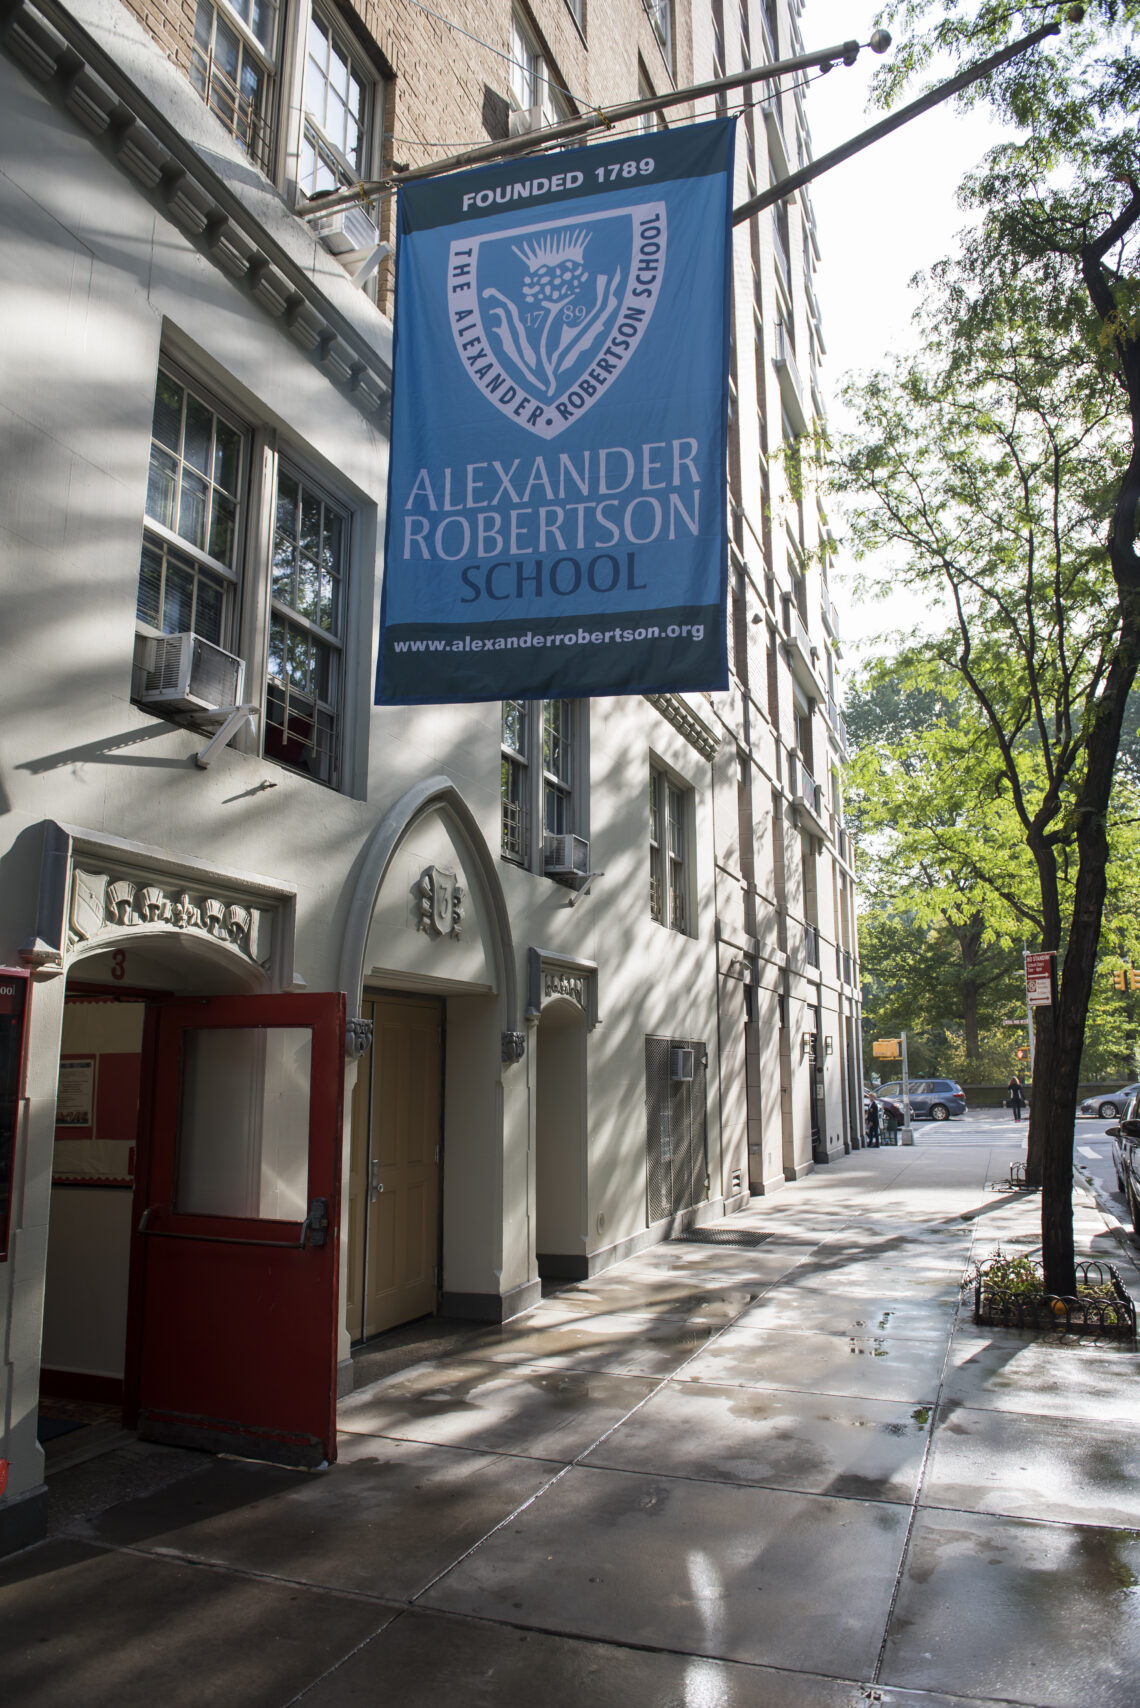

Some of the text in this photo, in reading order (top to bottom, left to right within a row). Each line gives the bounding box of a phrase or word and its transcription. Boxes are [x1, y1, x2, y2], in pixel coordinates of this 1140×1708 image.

[462, 157, 655, 212] FOUNDED 1789
[452, 213, 661, 427] THE ALEXANDER ROBERTSON SCHOOL
[524, 303, 587, 329] 17 89
[404, 437, 701, 512] ALEXANDER
[402, 489, 701, 561] ROBERTSON
[460, 552, 647, 603] SCHOOL
[393, 624, 705, 653] www.alexanderrobertson.org
[111, 949, 126, 981] 3
